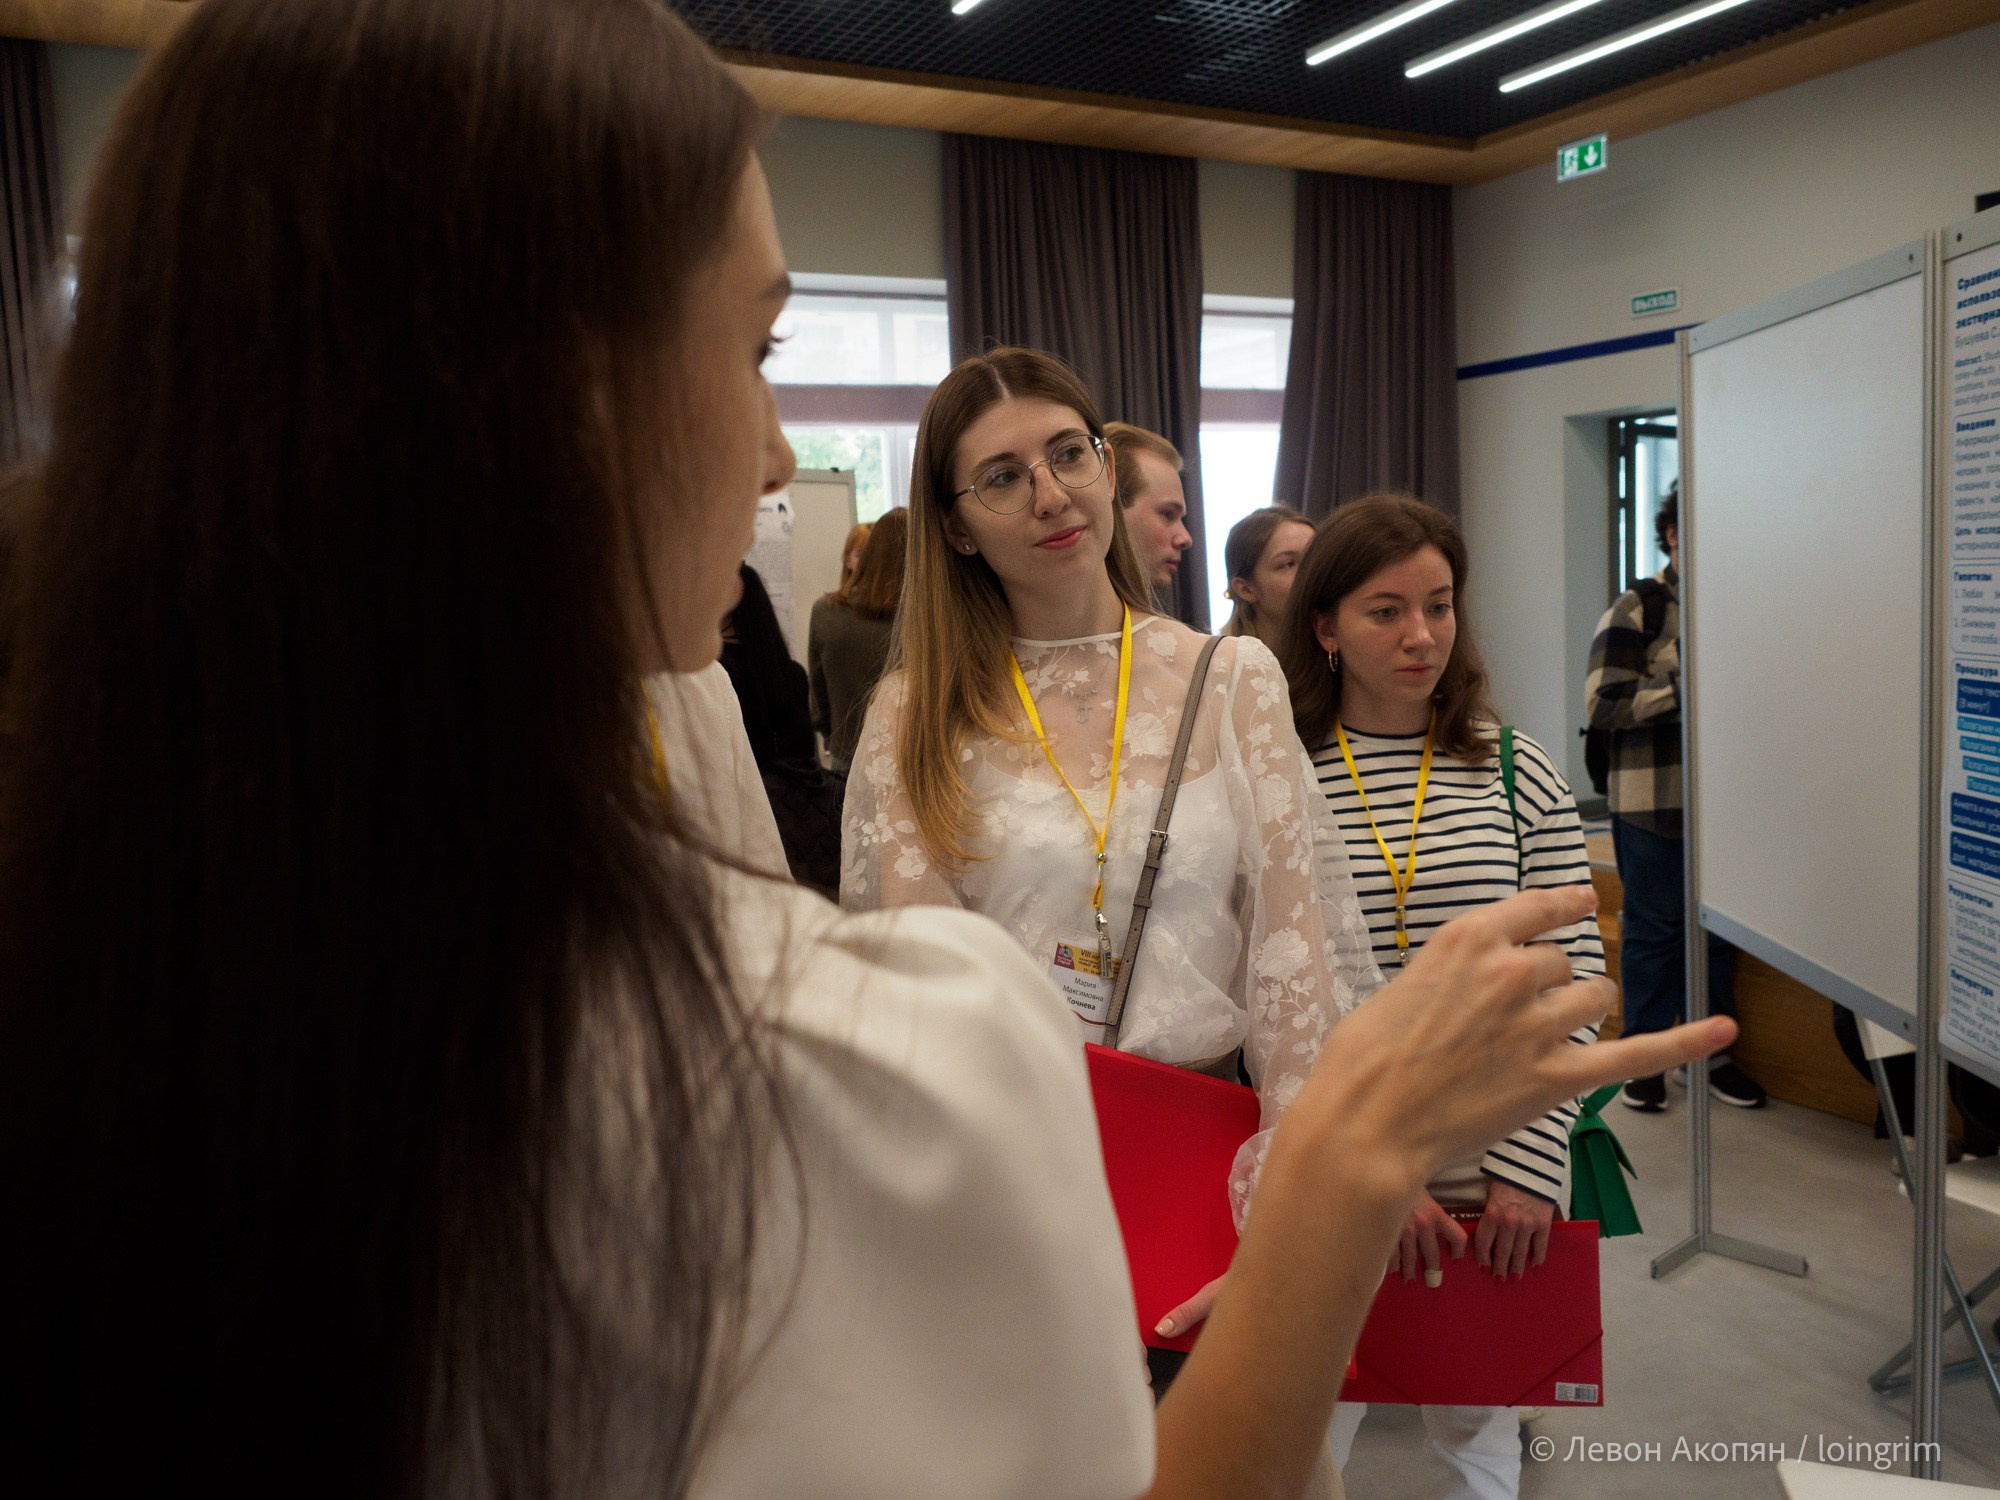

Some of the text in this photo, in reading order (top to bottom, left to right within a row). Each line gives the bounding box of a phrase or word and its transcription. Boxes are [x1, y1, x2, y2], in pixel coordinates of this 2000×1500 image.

[1634, 292, 1677, 311] ВЫХОД
[1956, 419, 1996, 432] Введение
[1954, 572, 1992, 581] Гипотезы
[1955, 662, 1998, 677] Процедура
[1948, 885, 1993, 908] Результаты
[1074, 977, 1097, 989] Мария
[1951, 969, 1994, 996] Литература
[1062, 985, 1104, 1002] Максимовна
[1067, 995, 1096, 1011] Кочнева
